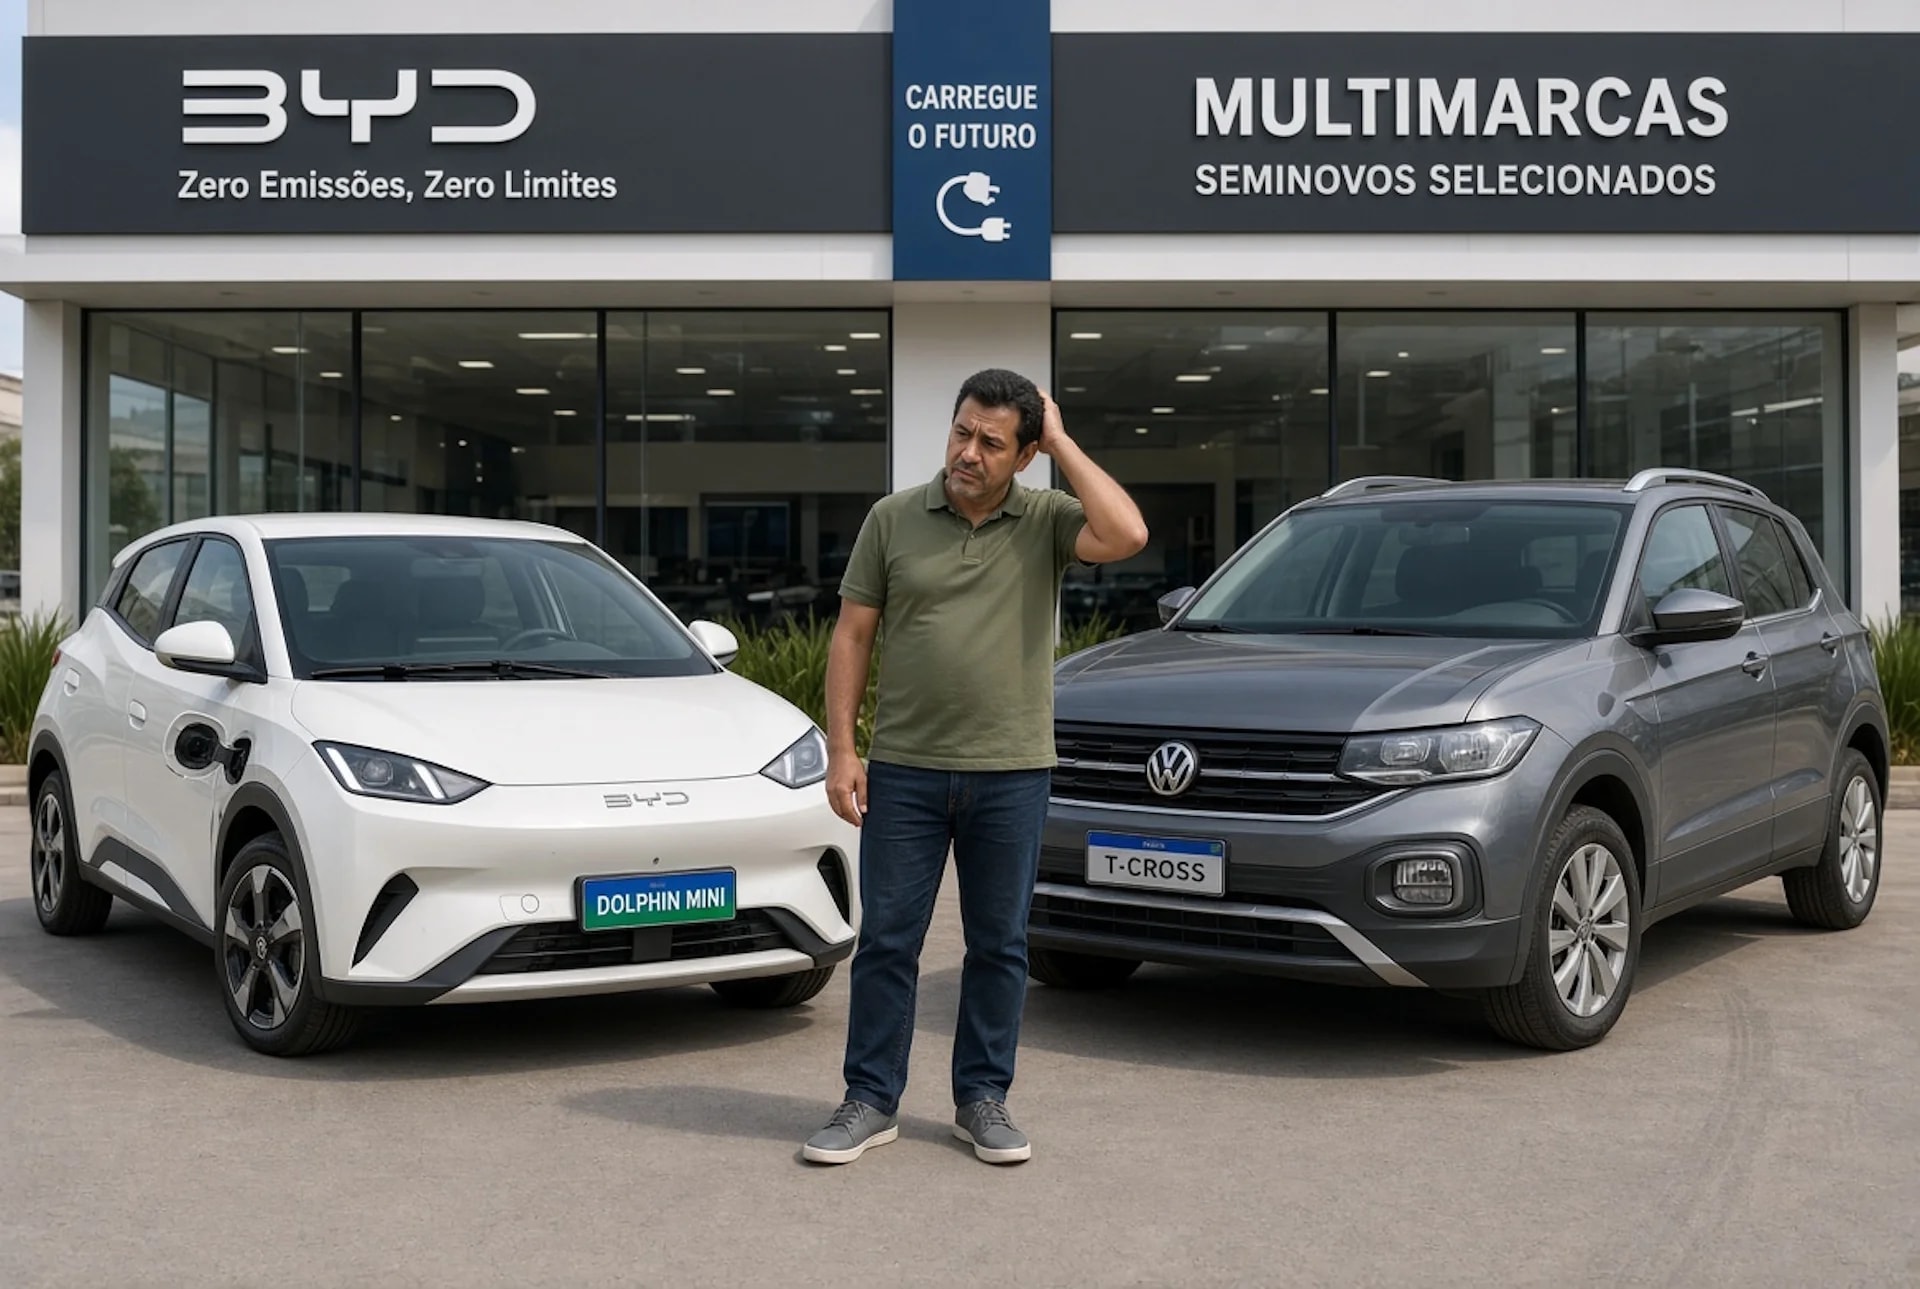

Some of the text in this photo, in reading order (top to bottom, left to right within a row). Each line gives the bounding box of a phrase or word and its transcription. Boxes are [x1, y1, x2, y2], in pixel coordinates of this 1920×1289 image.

[182, 69, 537, 143] BYD
[906, 84, 1038, 110] CARREGUE
[1195, 77, 1729, 137] MULTIMARCAS
[908, 123, 1037, 149] O FUTURO
[178, 169, 618, 204] Zero Emissões, Zero Limites
[1195, 163, 1716, 195] SEMINOVOS SELECIONADOS
[1148, 742, 1195, 795] VW
[603, 792, 689, 808] BYD
[1105, 855, 1205, 882] T-CROSS
[597, 887, 726, 916] DOLPHIN MINI
